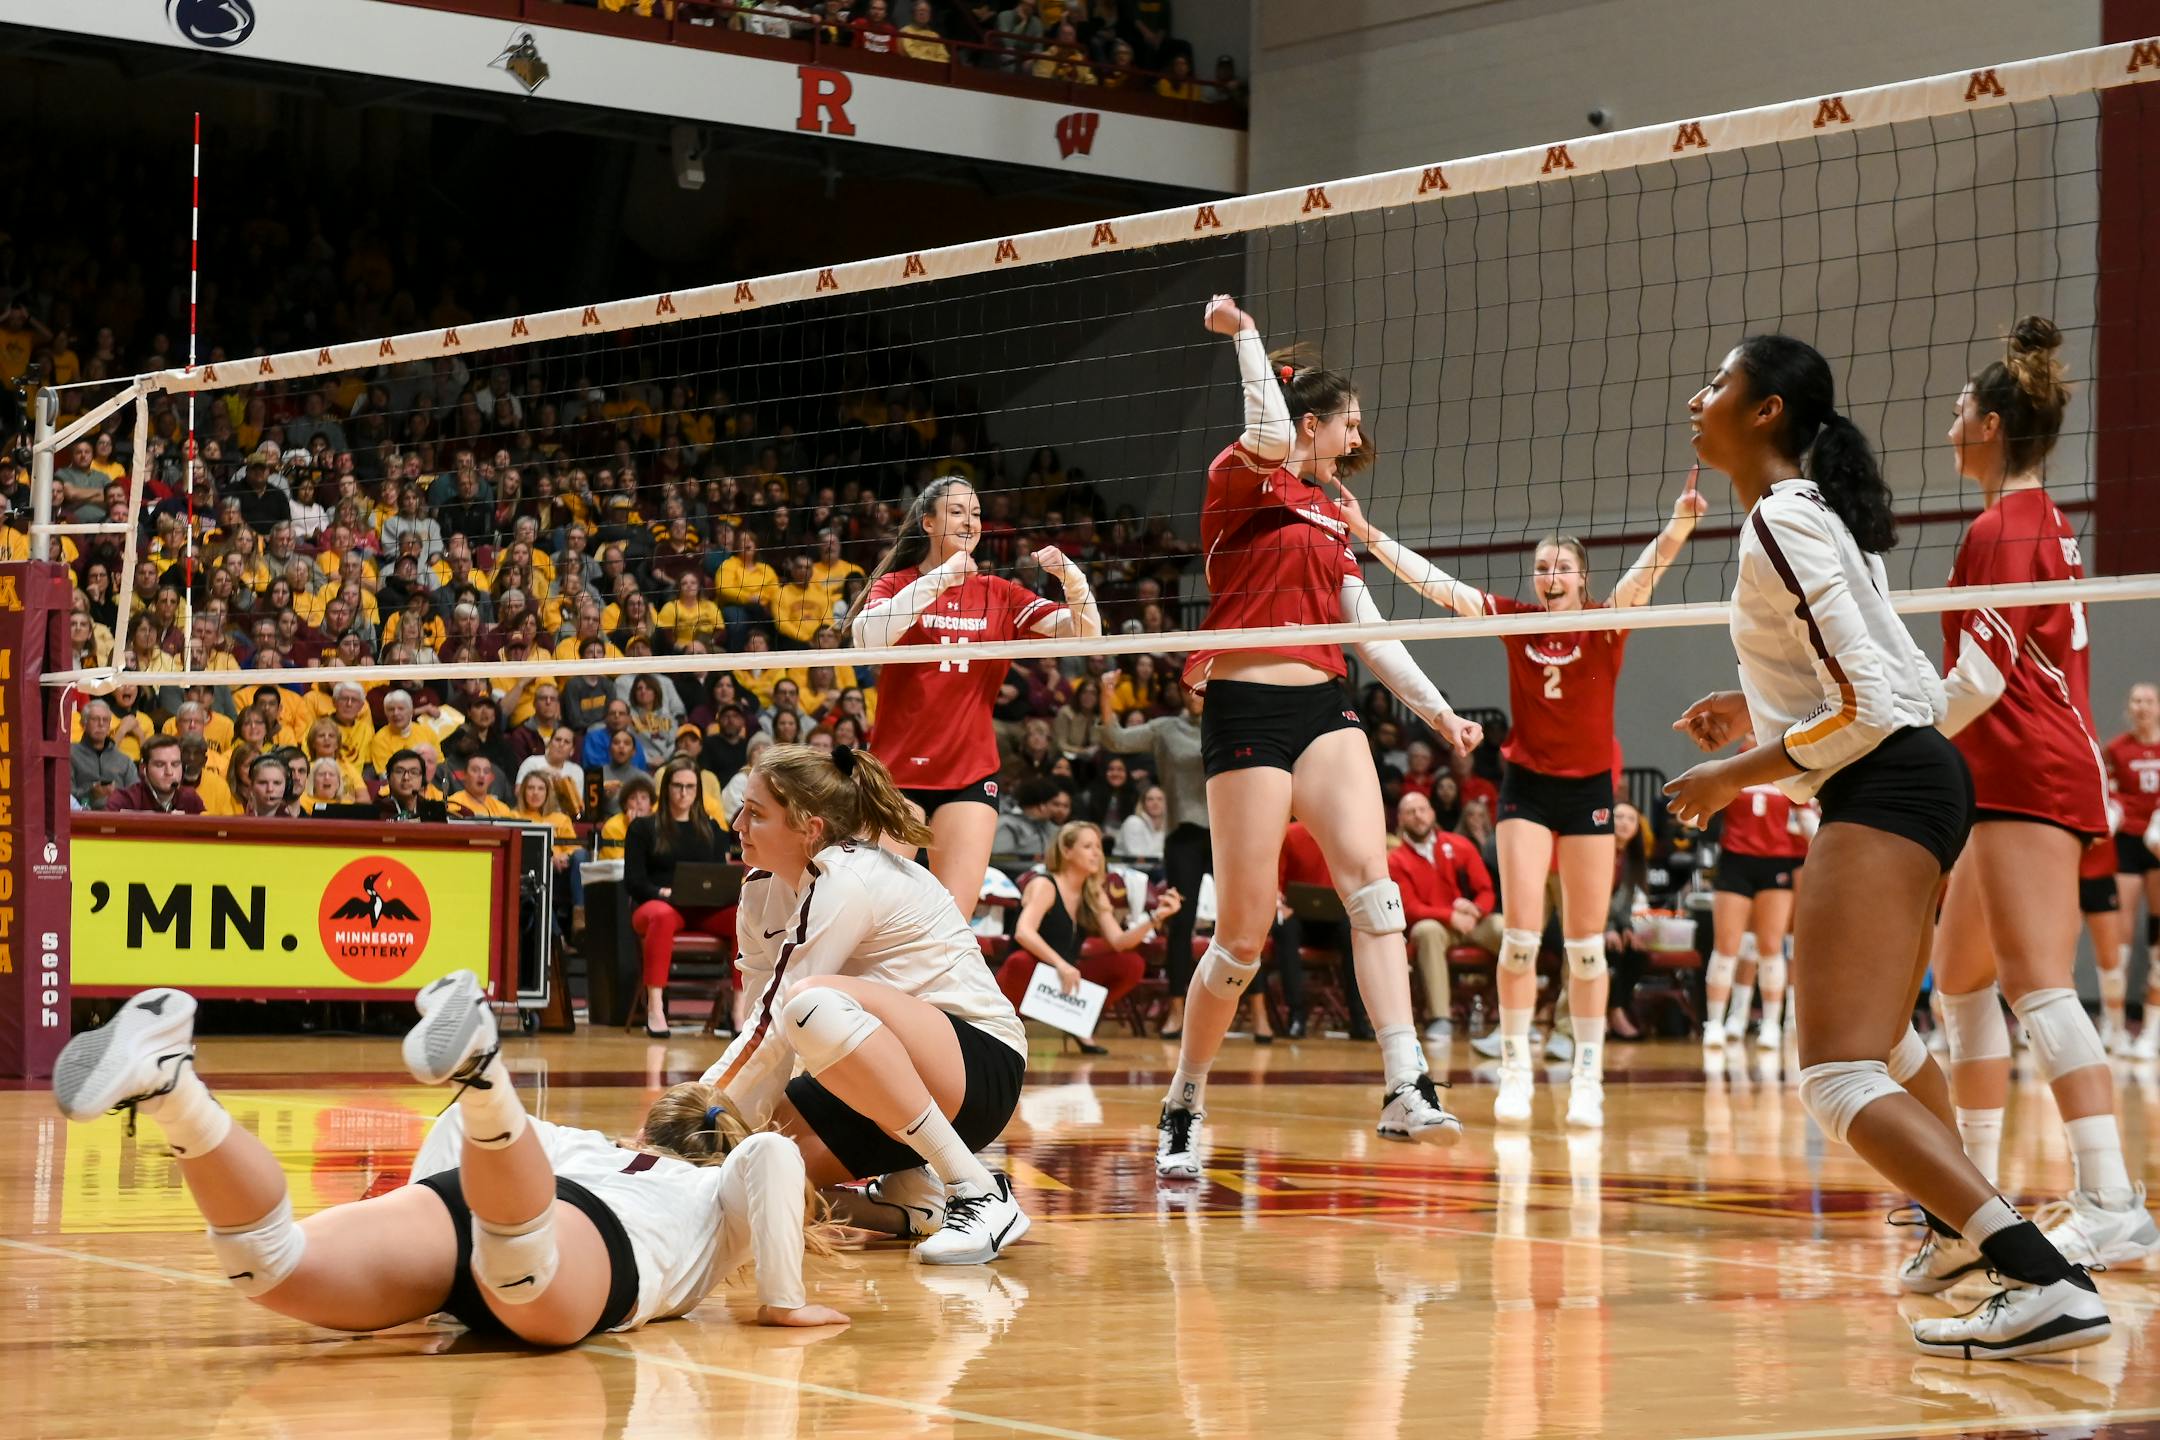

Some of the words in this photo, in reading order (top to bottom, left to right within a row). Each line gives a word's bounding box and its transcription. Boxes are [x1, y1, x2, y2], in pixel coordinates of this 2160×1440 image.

[2124, 41, 2160, 74] M
[1963, 69, 2008, 103] M
[796, 65, 856, 137] R
[1812, 96, 1854, 129] M
[1055, 111, 1100, 161] W
[1671, 122, 1710, 153] M
[1540, 144, 1577, 175] M
[1417, 167, 1451, 195] M
[1301, 187, 1332, 214] M
[1193, 206, 1223, 232] M
[1090, 222, 1119, 249] M
[994, 239, 1021, 265] M
[902, 255, 929, 279] M
[815, 268, 840, 293] M
[655, 295, 678, 317] M
[733, 282, 757, 305] M
[510, 318, 530, 339] M
[581, 307, 602, 328] M
[378, 339, 396, 358] M
[442, 329, 461, 348] M
[258, 357, 275, 376] M
[317, 348, 333, 367] M
[202, 365, 218, 384] M
[1543, 665, 1563, 699] 2
[335, 930, 414, 945] MINNESOTA
[341, 945, 407, 957] LOTTERY
